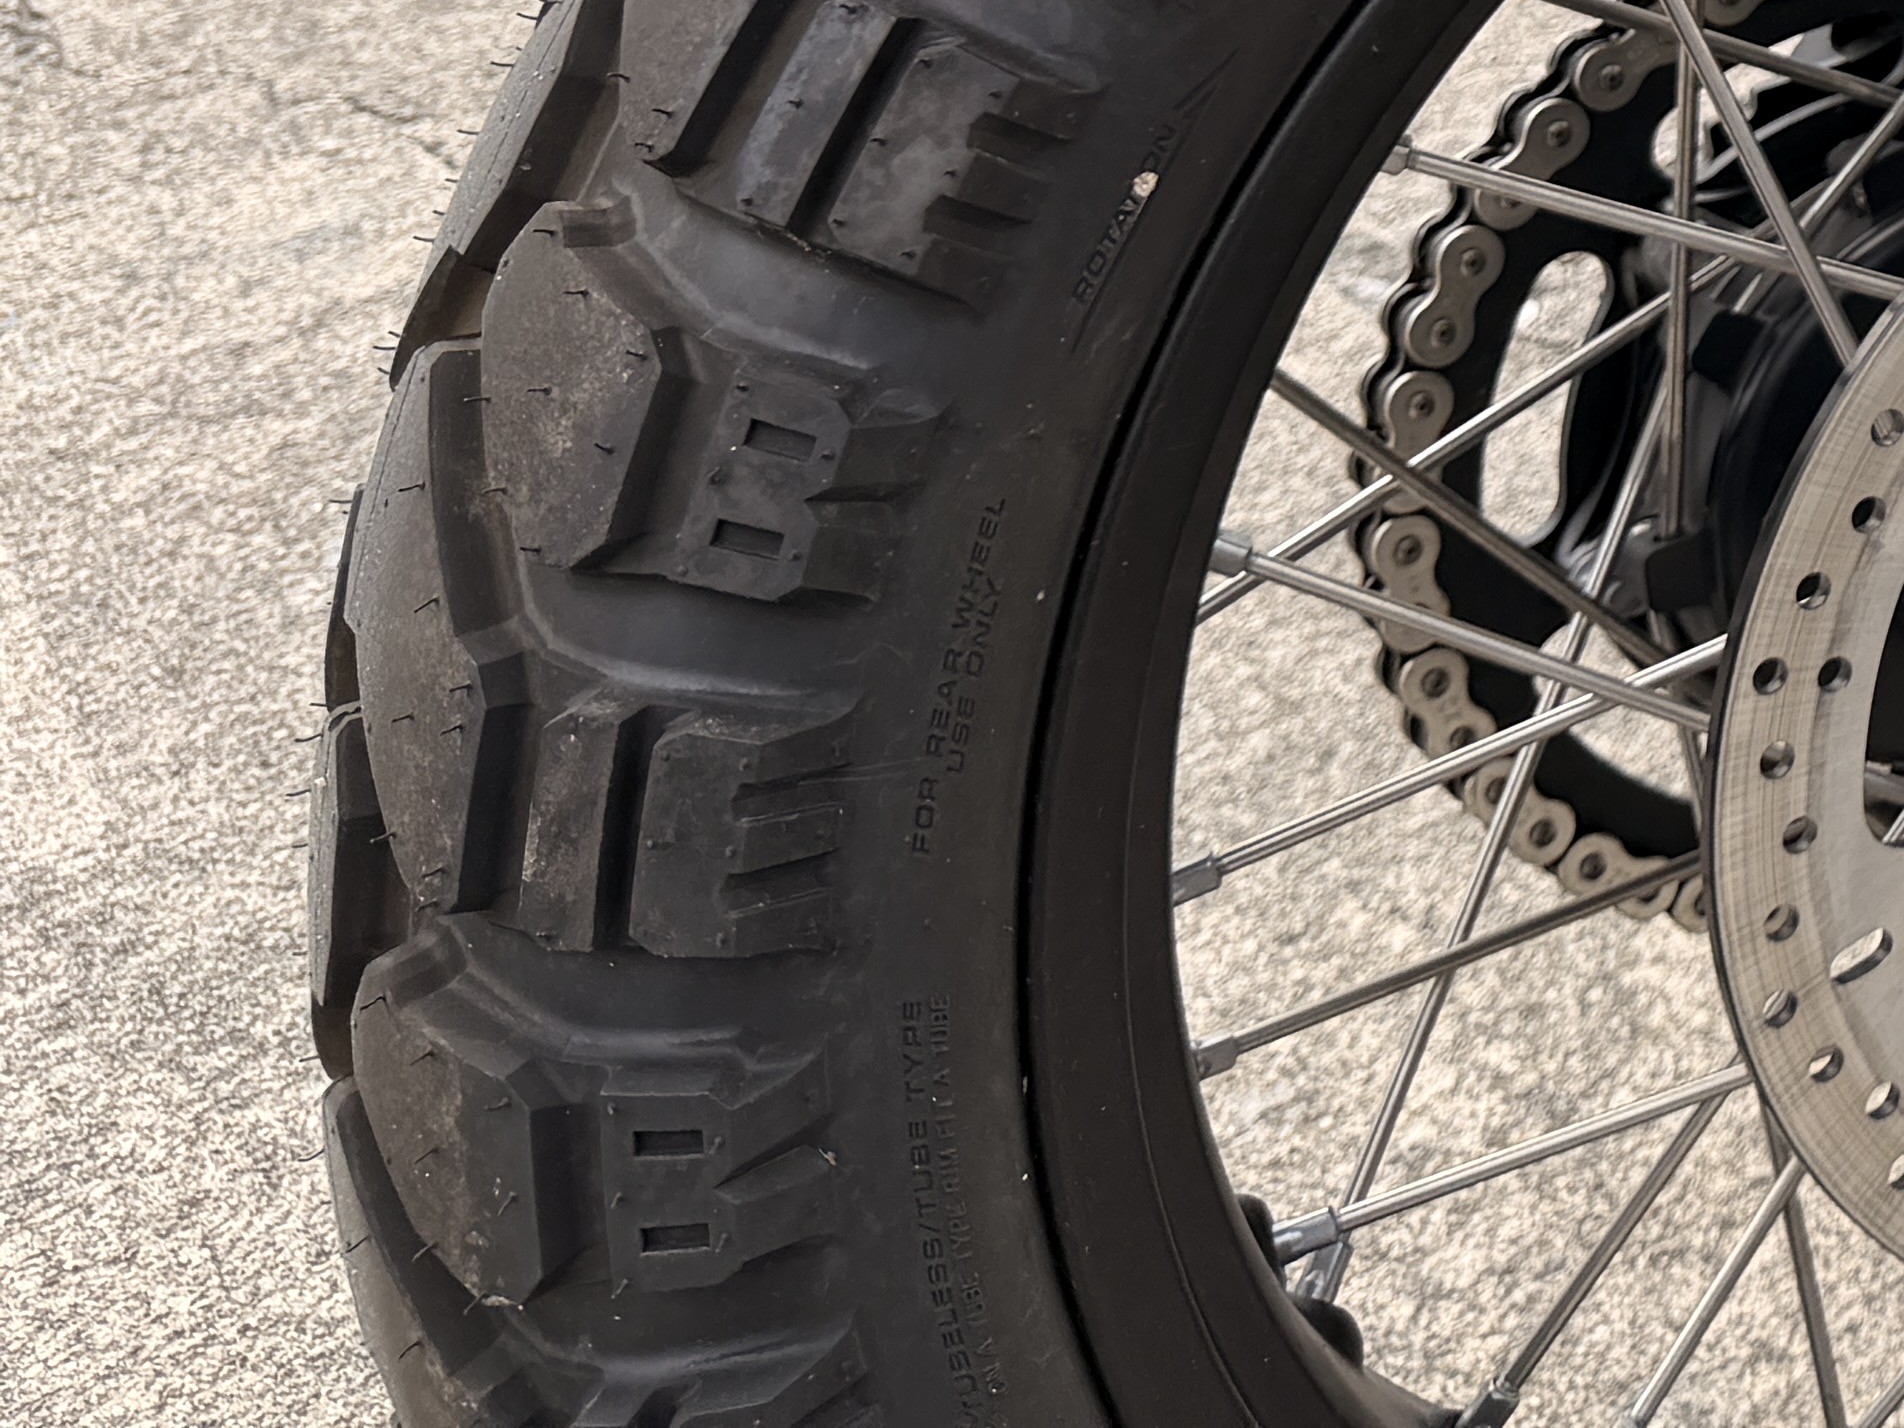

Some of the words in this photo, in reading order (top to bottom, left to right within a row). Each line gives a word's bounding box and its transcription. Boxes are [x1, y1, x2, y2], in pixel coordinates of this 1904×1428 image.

[1071, 122, 1178, 306] ROTATON
[911, 776, 939, 855] FOR
[925, 647, 965, 760] REAR
[952, 497, 1007, 631] WHEEL
[946, 693, 978, 775] USE
[966, 582, 1002, 679] ONLY
[901, 1000, 926, 1104] TYPE
